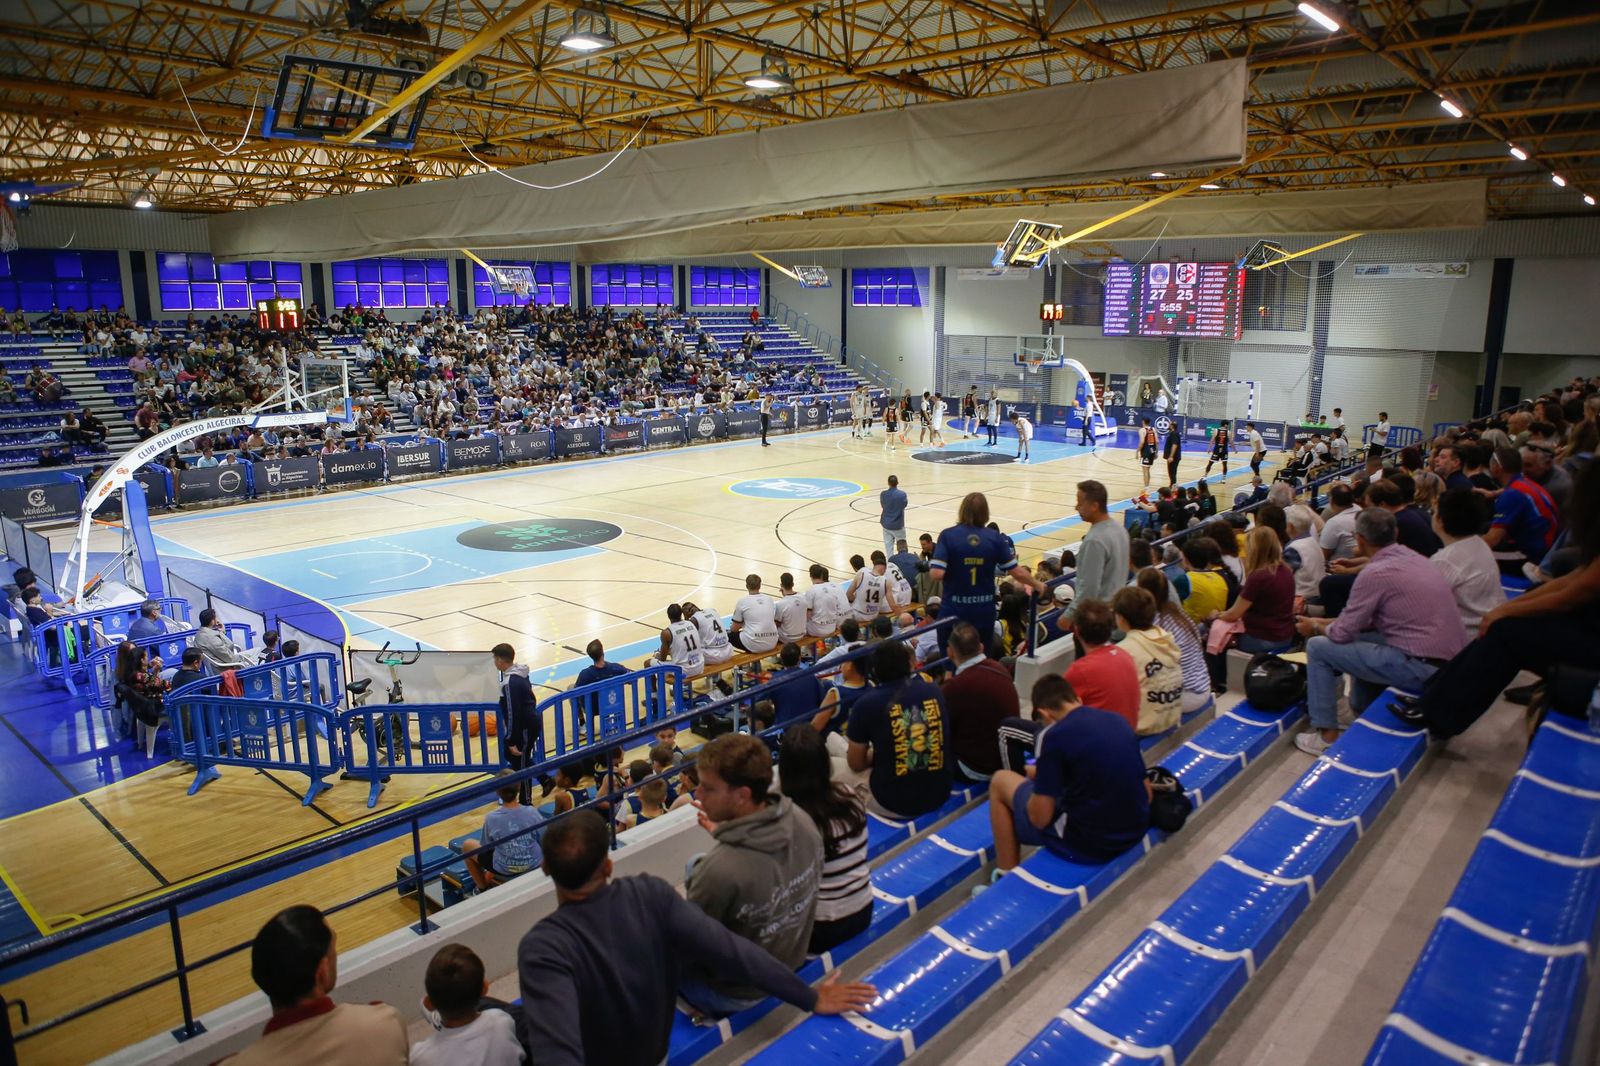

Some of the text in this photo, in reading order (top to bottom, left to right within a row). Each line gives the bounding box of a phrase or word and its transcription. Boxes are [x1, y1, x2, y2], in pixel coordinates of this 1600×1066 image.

[1150, 289, 1168, 301] 27
[1176, 289, 1194, 301] 25
[1159, 303, 1182, 312] 5:55
[280, 311, 298, 329] 17
[138, 416, 247, 460] CLUB BALONCESTO ALGECIRAS
[651, 425, 681, 436] CENTRAL
[530, 441, 548, 450] ROA
[397, 451, 430, 465] IBERSUR
[331, 460, 377, 474] damex.io
[969, 566, 978, 587] 1
[864, 588, 880, 604] 14
[712, 618, 724, 634] 4
[682, 634, 698, 653] 11
[891, 718, 909, 777] SEABASS
